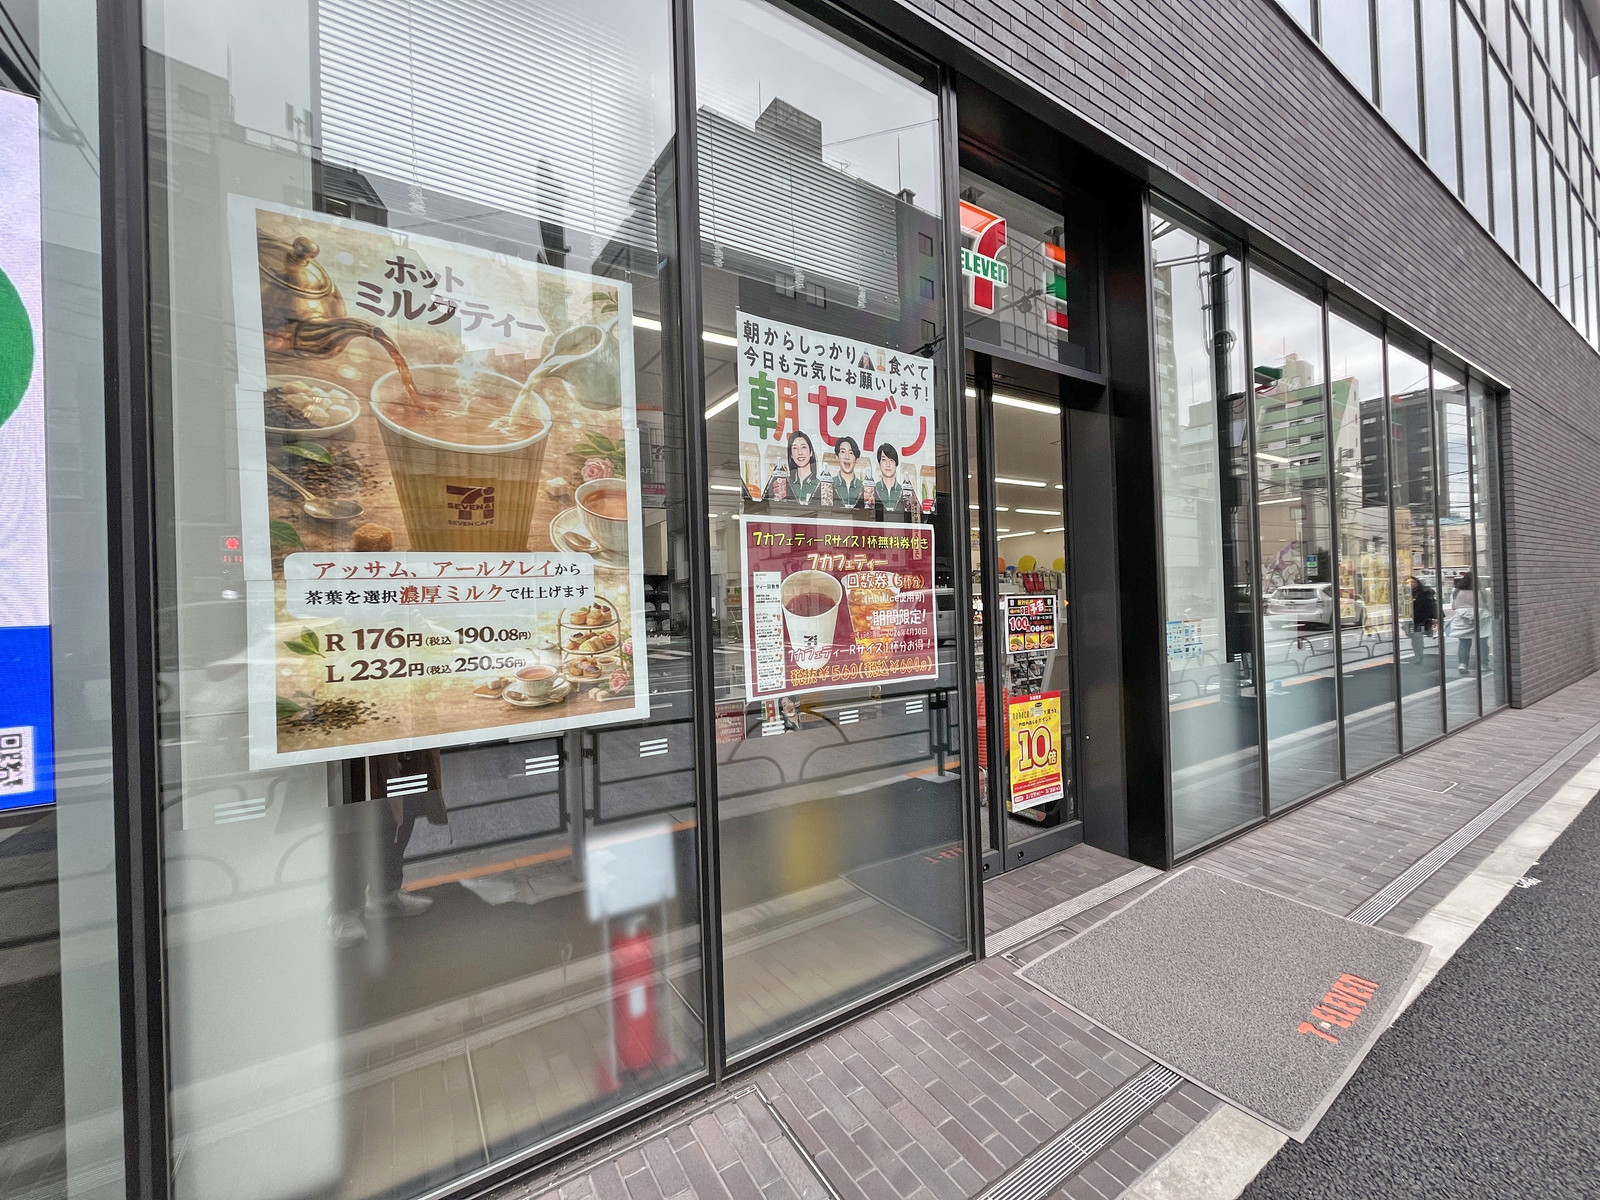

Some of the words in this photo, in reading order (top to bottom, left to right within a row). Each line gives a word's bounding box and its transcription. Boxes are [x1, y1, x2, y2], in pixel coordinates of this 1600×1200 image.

[385, 256, 464, 293] ホット
[356, 281, 546, 338] ミルクティー
[743, 320, 856, 365] 朝からしっかり
[889, 355, 929, 381] 食べて
[748, 371, 927, 457] 朝セブン
[305, 583, 589, 605] 茶葉を選択濃厚ミルクで仕上げます
[325, 633, 346, 652] R
[325, 665, 344, 683] L
